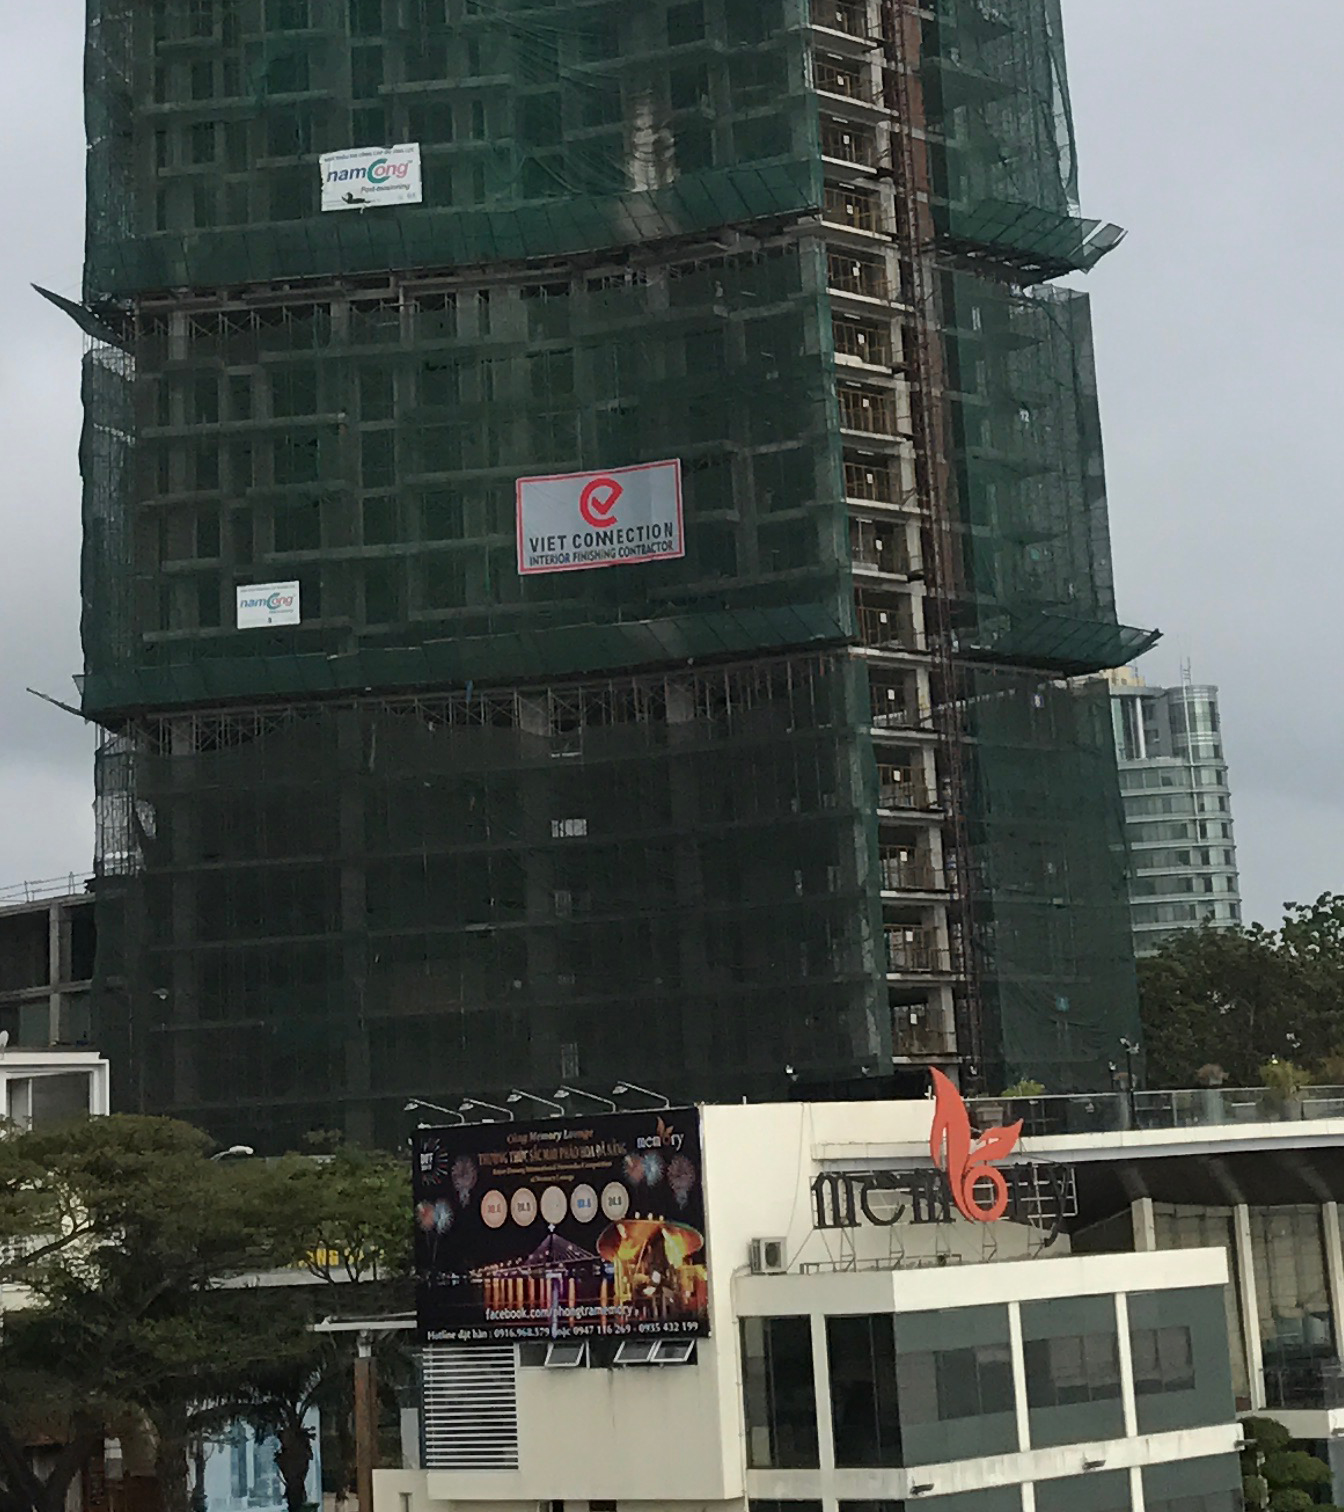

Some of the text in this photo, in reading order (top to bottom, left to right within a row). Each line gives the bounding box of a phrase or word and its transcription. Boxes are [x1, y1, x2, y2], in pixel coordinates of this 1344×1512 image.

[529, 522, 673, 552] VIET CONNECTION
[529, 540, 674, 567] INTERIOR FINISHING CONTRACTOR
[573, 1325, 594, 1335] 0947
[663, 1322, 679, 1332] 432
[682, 1321, 698, 1332] 199
